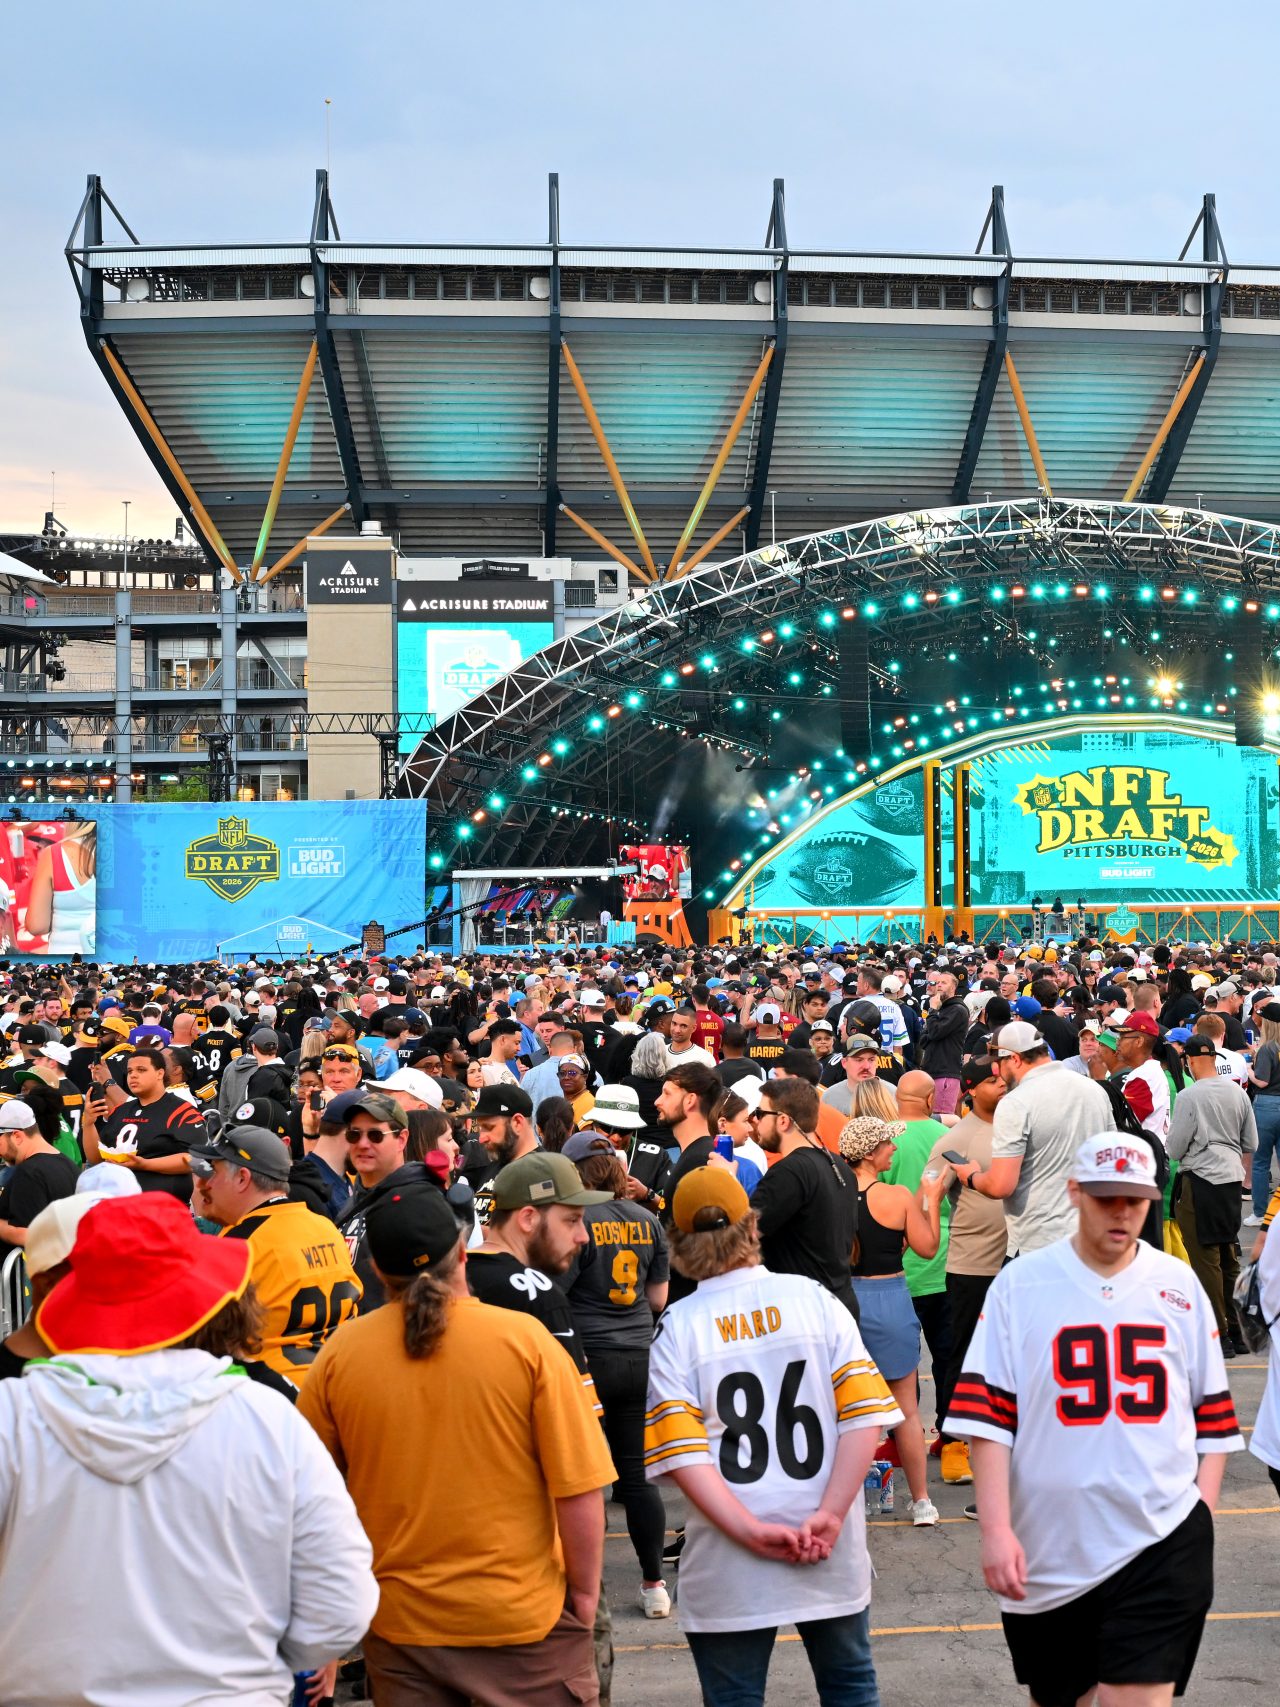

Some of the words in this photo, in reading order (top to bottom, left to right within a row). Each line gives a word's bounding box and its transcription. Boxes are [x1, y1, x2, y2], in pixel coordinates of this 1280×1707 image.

[319, 578, 379, 587] ACRISURE
[420, 599, 488, 610] ACRISURE
[1060, 766, 1182, 807] NFL
[221, 829, 242, 845] NFL
[1037, 808, 1209, 853] DRAFT
[299, 850, 334, 862] BUD
[1064, 845, 1182, 858] PITTSBURGH
[1191, 842, 1217, 857] 2026
[193, 856, 271, 871] DRAFT
[292, 861, 341, 875] LIGHT
[817, 874, 849, 882] DRAFT
[1101, 869, 1123, 877] BUD
[1124, 869, 1152, 877] LIGHT
[279, 932, 306, 940] LIGHT
[783, 1022, 798, 1031] ANIELS
[750, 1046, 784, 1058] HARRIS
[210, 1049, 221, 1071] 8
[1096, 1146, 1148, 1169] BROWNS
[591, 1221, 653, 1246] BOSWELL
[301, 1243, 338, 1270] WATT
[510, 1267, 553, 1300] 90
[609, 1250, 639, 1305] 9
[715, 1306, 782, 1343] WARD
[1053, 1324, 1168, 1427] 95
[717, 1360, 825, 1484] 86
